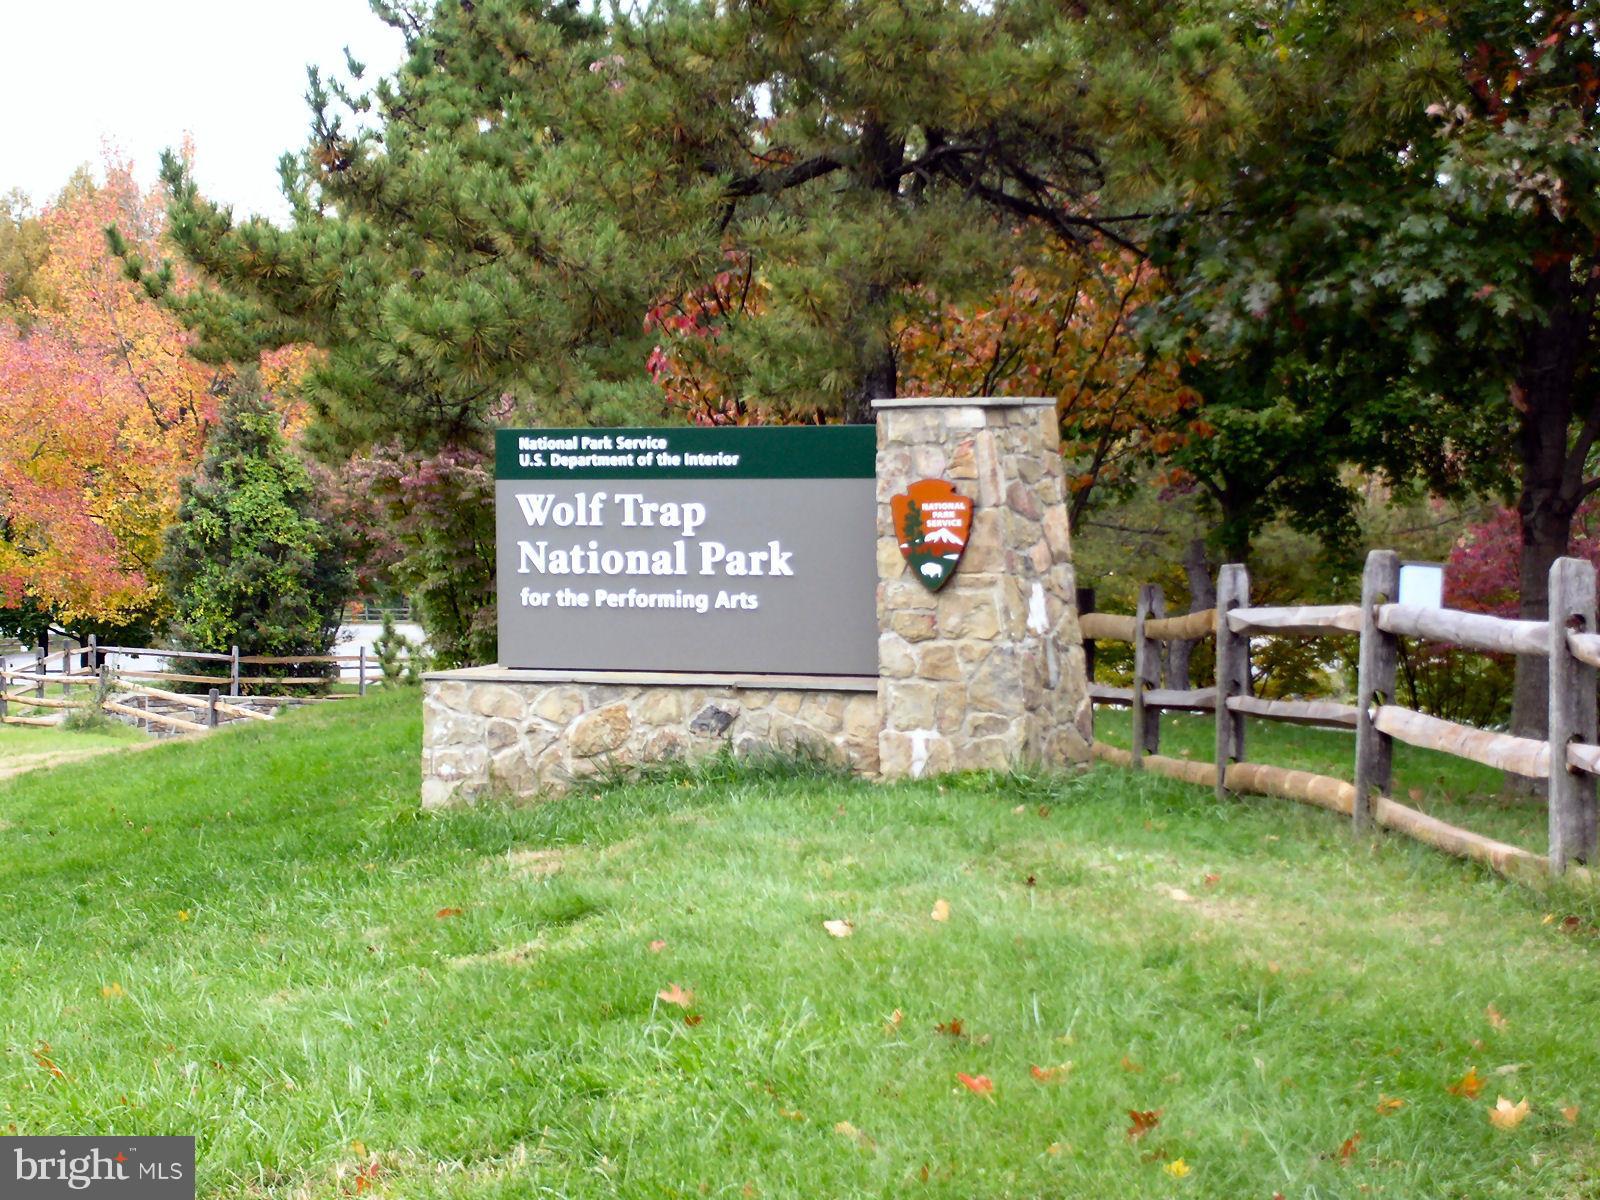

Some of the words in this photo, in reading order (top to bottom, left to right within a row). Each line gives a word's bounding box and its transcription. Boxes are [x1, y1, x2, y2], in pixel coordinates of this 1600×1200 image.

[518, 436, 579, 450] National
[581, 436, 613, 450] Park
[616, 436, 668, 450] Service
[518, 454, 547, 467] U.S.
[550, 453, 635, 470] Department
[636, 452, 654, 466] of
[656, 452, 681, 466] the
[684, 452, 740, 466] Interior
[515, 491, 607, 527] Wolf
[614, 493, 706, 537] Trap
[921, 502, 965, 510] NATIONAL
[926, 519, 962, 527] SERVICE
[516, 540, 688, 575] National
[698, 540, 795, 576] Park
[519, 587, 551, 608] for
[555, 587, 589, 608] the
[594, 588, 709, 614] Performing
[714, 590, 759, 610] Arts
